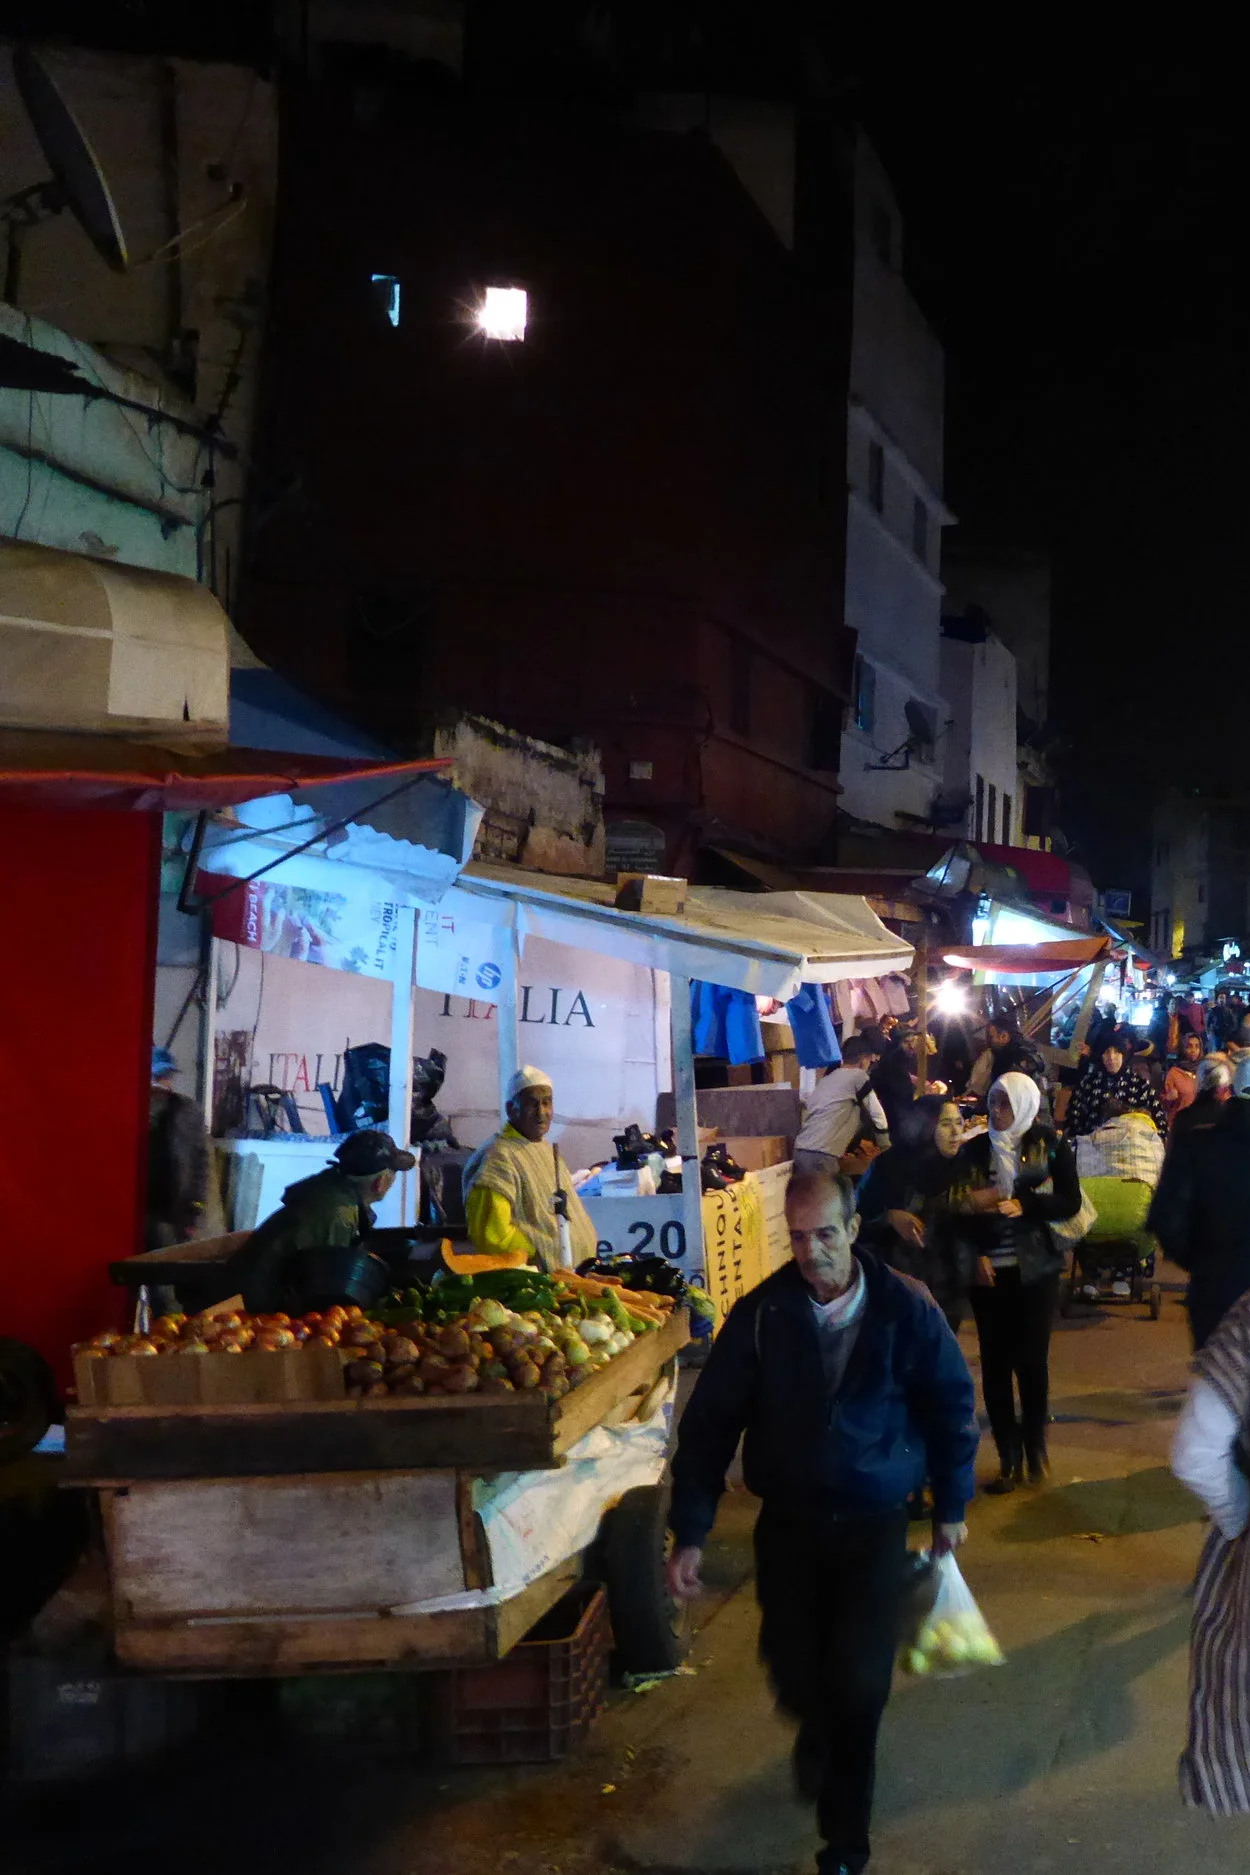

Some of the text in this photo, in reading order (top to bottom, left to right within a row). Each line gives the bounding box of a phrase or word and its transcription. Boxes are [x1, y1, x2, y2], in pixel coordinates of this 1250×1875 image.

[246, 891, 258, 943] BEACH
[376, 902, 395, 955] TROPICAL
[269, 1053, 344, 1093] ITALI
[628, 1220, 687, 1260] 20
